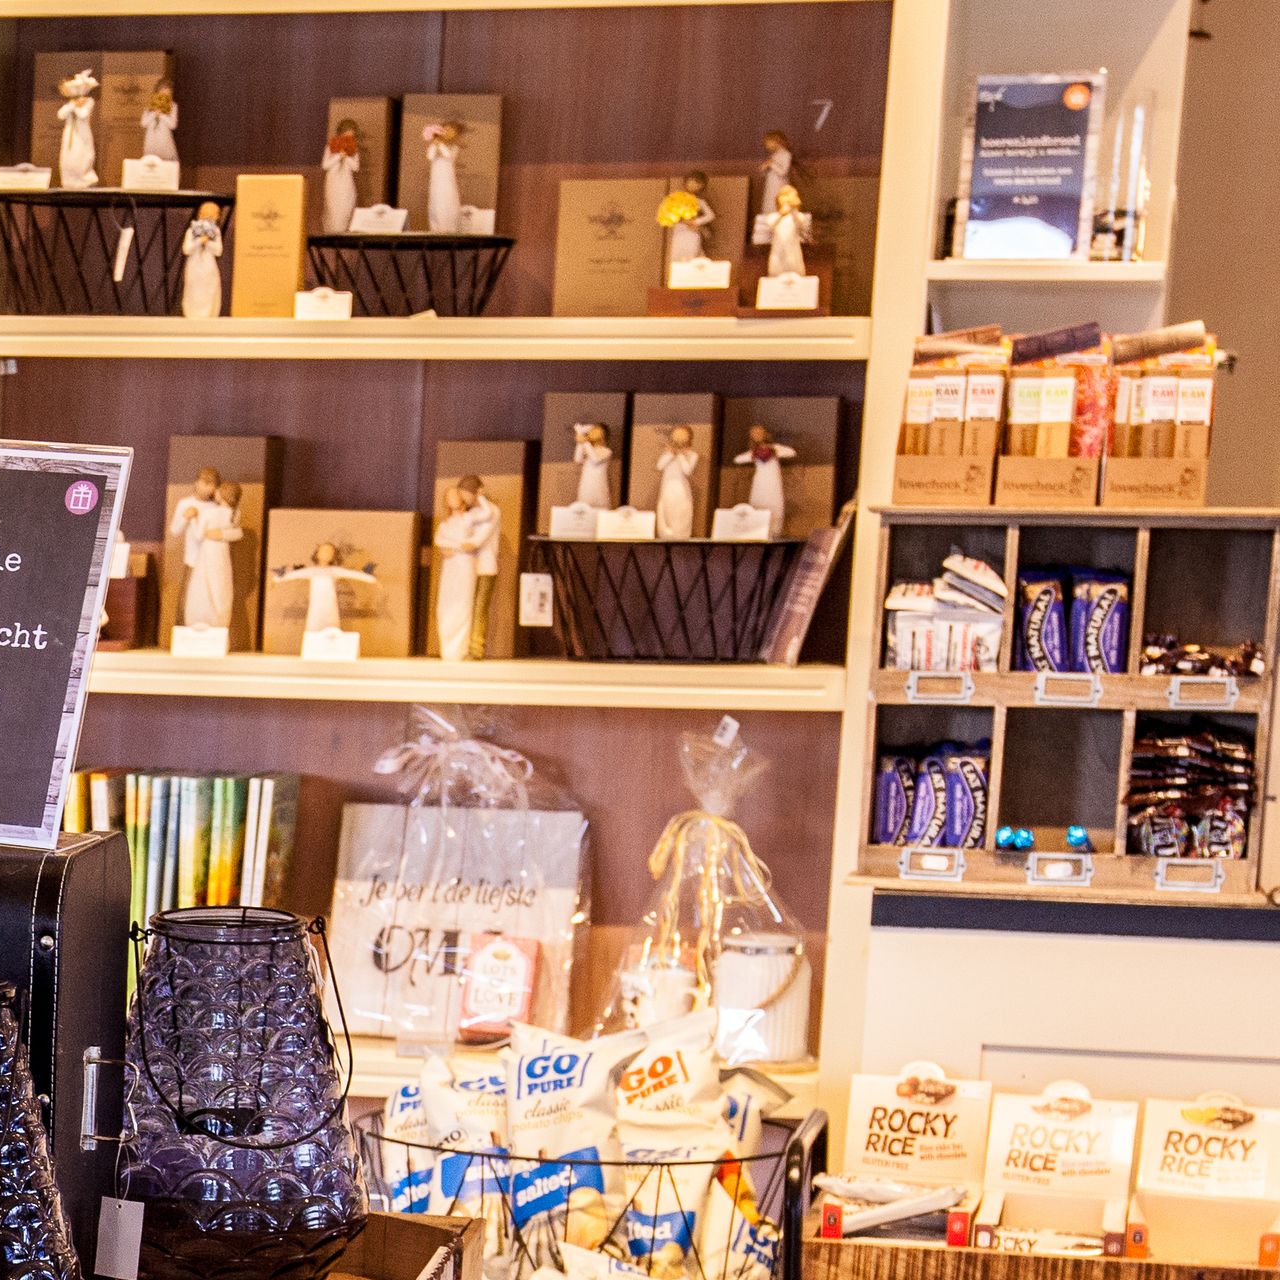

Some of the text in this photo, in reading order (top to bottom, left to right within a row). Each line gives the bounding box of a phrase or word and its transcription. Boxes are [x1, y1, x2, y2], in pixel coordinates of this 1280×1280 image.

[934, 387, 960, 397] RAW
[971, 387, 996, 396] RAW
[1027, 592, 1052, 659] NATURAL
[1085, 590, 1117, 656] NATURAL
[360, 875, 387, 908] Je
[443, 877, 470, 902] de
[473, 881, 538, 910] liefste
[481, 963, 518, 977] LOTS
[473, 989, 520, 1005] LOVE
[526, 1053, 580, 1080] GO
[619, 1055, 674, 1093] GO
[526, 1076, 577, 1095] PURE
[625, 1073, 679, 1106] PURE
[524, 1096, 572, 1120] classic
[549, 1110, 584, 1127] chips
[868, 1106, 958, 1139] ROCKY
[864, 1132, 917, 1157] RICE
[1009, 1122, 1103, 1155] ROCKY
[1163, 1130, 1258, 1163] ROCKY
[891, 1160, 910, 1171] FREE
[1005, 1148, 1059, 1172] RICE
[1159, 1154, 1214, 1178] RICE
[515, 1173, 578, 1207] salted
